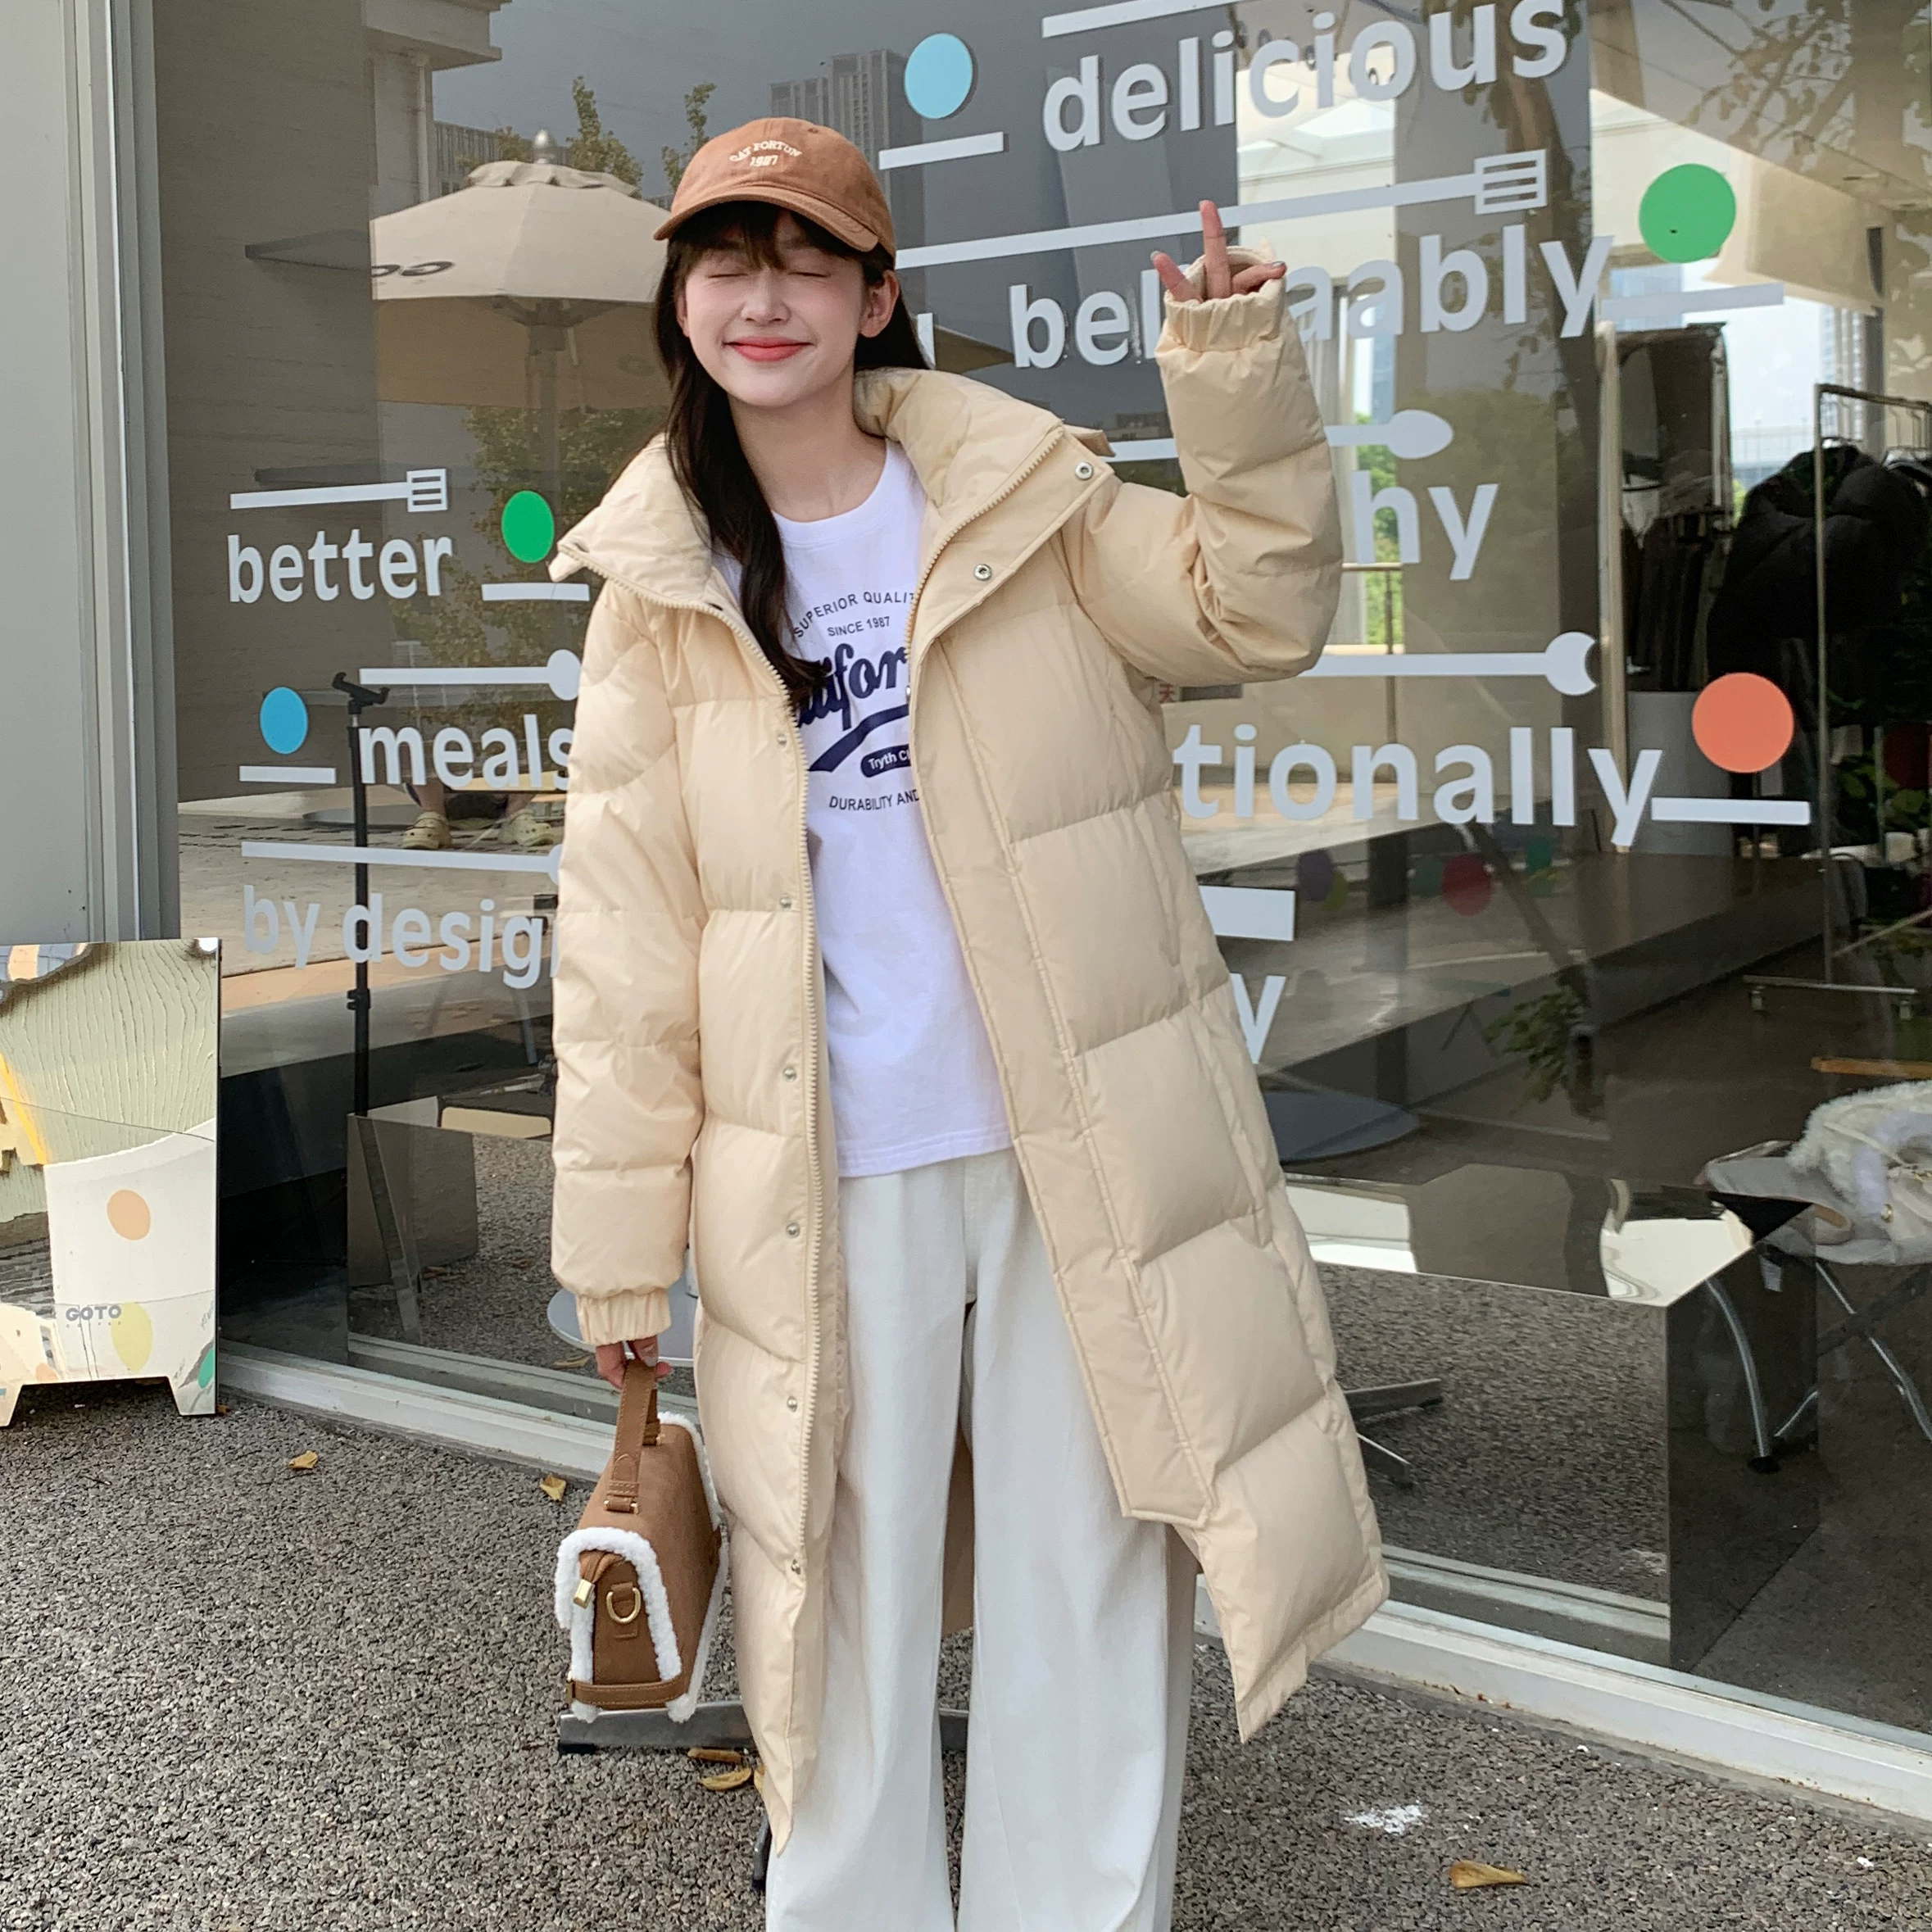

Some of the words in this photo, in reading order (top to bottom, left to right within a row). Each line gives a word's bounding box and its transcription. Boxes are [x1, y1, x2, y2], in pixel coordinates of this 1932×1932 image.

[1043, 0, 1567, 151] delicious
[227, 528, 453, 604] better
[793, 593, 859, 637] SUPERIOR
[827, 620, 864, 637] SINCE
[867, 615, 891, 628] 1987
[829, 796, 892, 810] DURABILITY
[244, 884, 320, 969] by
[66, 1304, 122, 1322] GOTO
